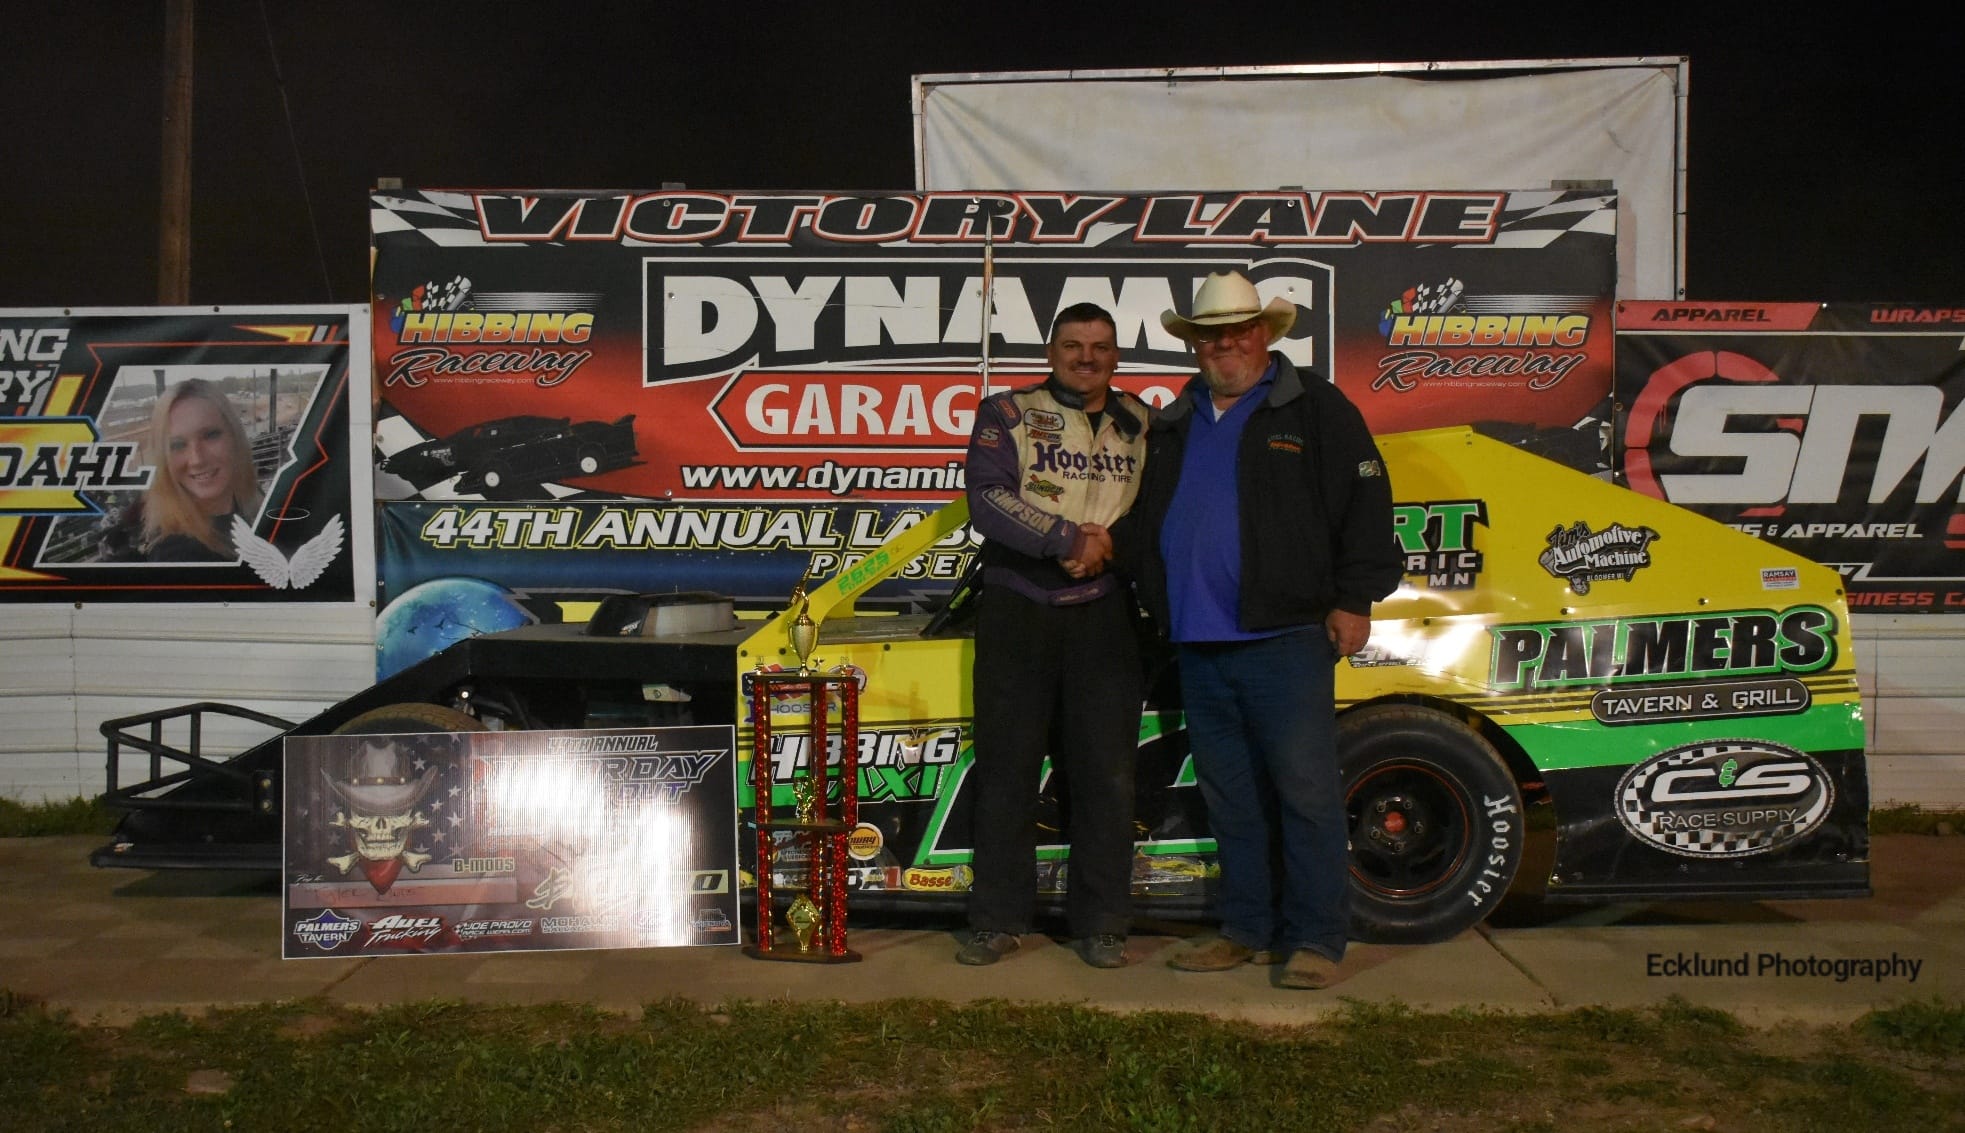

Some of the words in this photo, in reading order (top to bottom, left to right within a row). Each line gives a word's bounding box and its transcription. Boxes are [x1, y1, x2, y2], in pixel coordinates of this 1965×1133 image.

[476, 191, 1128, 243] VICTORY
[1134, 190, 1505, 242] LANE
[664, 275, 1313, 366] DYNAMC
[1651, 308, 1771, 322] APPAREL
[1870, 309, 1965, 323] WRAPS
[400, 312, 594, 344] HIBBING
[1389, 315, 1590, 347] HIBBING
[384, 347, 593, 389] Raceway
[1370, 349, 1588, 392] Raceway
[433, 377, 536, 385] www.hibbingraceway.com
[1423, 381, 1527, 389] www.hibbingraceway.com
[744, 383, 1012, 436] GARAG
[1029, 441, 1136, 474] Hoosier
[1063, 470, 1106, 482] RACING
[1112, 474, 1133, 484] TIRE
[989, 485, 1055, 535] SIMPSON
[421, 509, 574, 549] 44TH
[574, 510, 842, 548] ANNUAL
[848, 511, 986, 548] LA
[1393, 503, 1479, 553] RT
[1766, 524, 1779, 537] &
[1780, 523, 1924, 538] APPAREL
[1553, 525, 1642, 565] Automotive
[811, 553, 976, 576] PSE
[1407, 552, 1477, 571] RIC
[1584, 550, 1648, 568] Machine
[1429, 573, 1469, 587] MN
[1763, 570, 1795, 578] RAMSAY
[1494, 608, 1829, 686] PALMERS
[768, 702, 838, 716] HOOSR
[1602, 694, 1692, 716] TAVERN
[1702, 692, 1718, 710] &
[1732, 687, 1800, 707] GRILL
[590, 734, 659, 752] ANNUAL
[751, 731, 960, 780] HIBBING
[1659, 812, 1718, 830] RACE
[1724, 808, 1798, 827] SUPPLY
[1467, 794, 1518, 907] Hoosier
[453, 857, 515, 872] B-MODS
[297, 921, 358, 932] PALMERS
[465, 922, 489, 931] JOE
[490, 920, 533, 930] PROVO
[301, 933, 348, 942] TAVERN
[363, 926, 442, 948] Trucking
